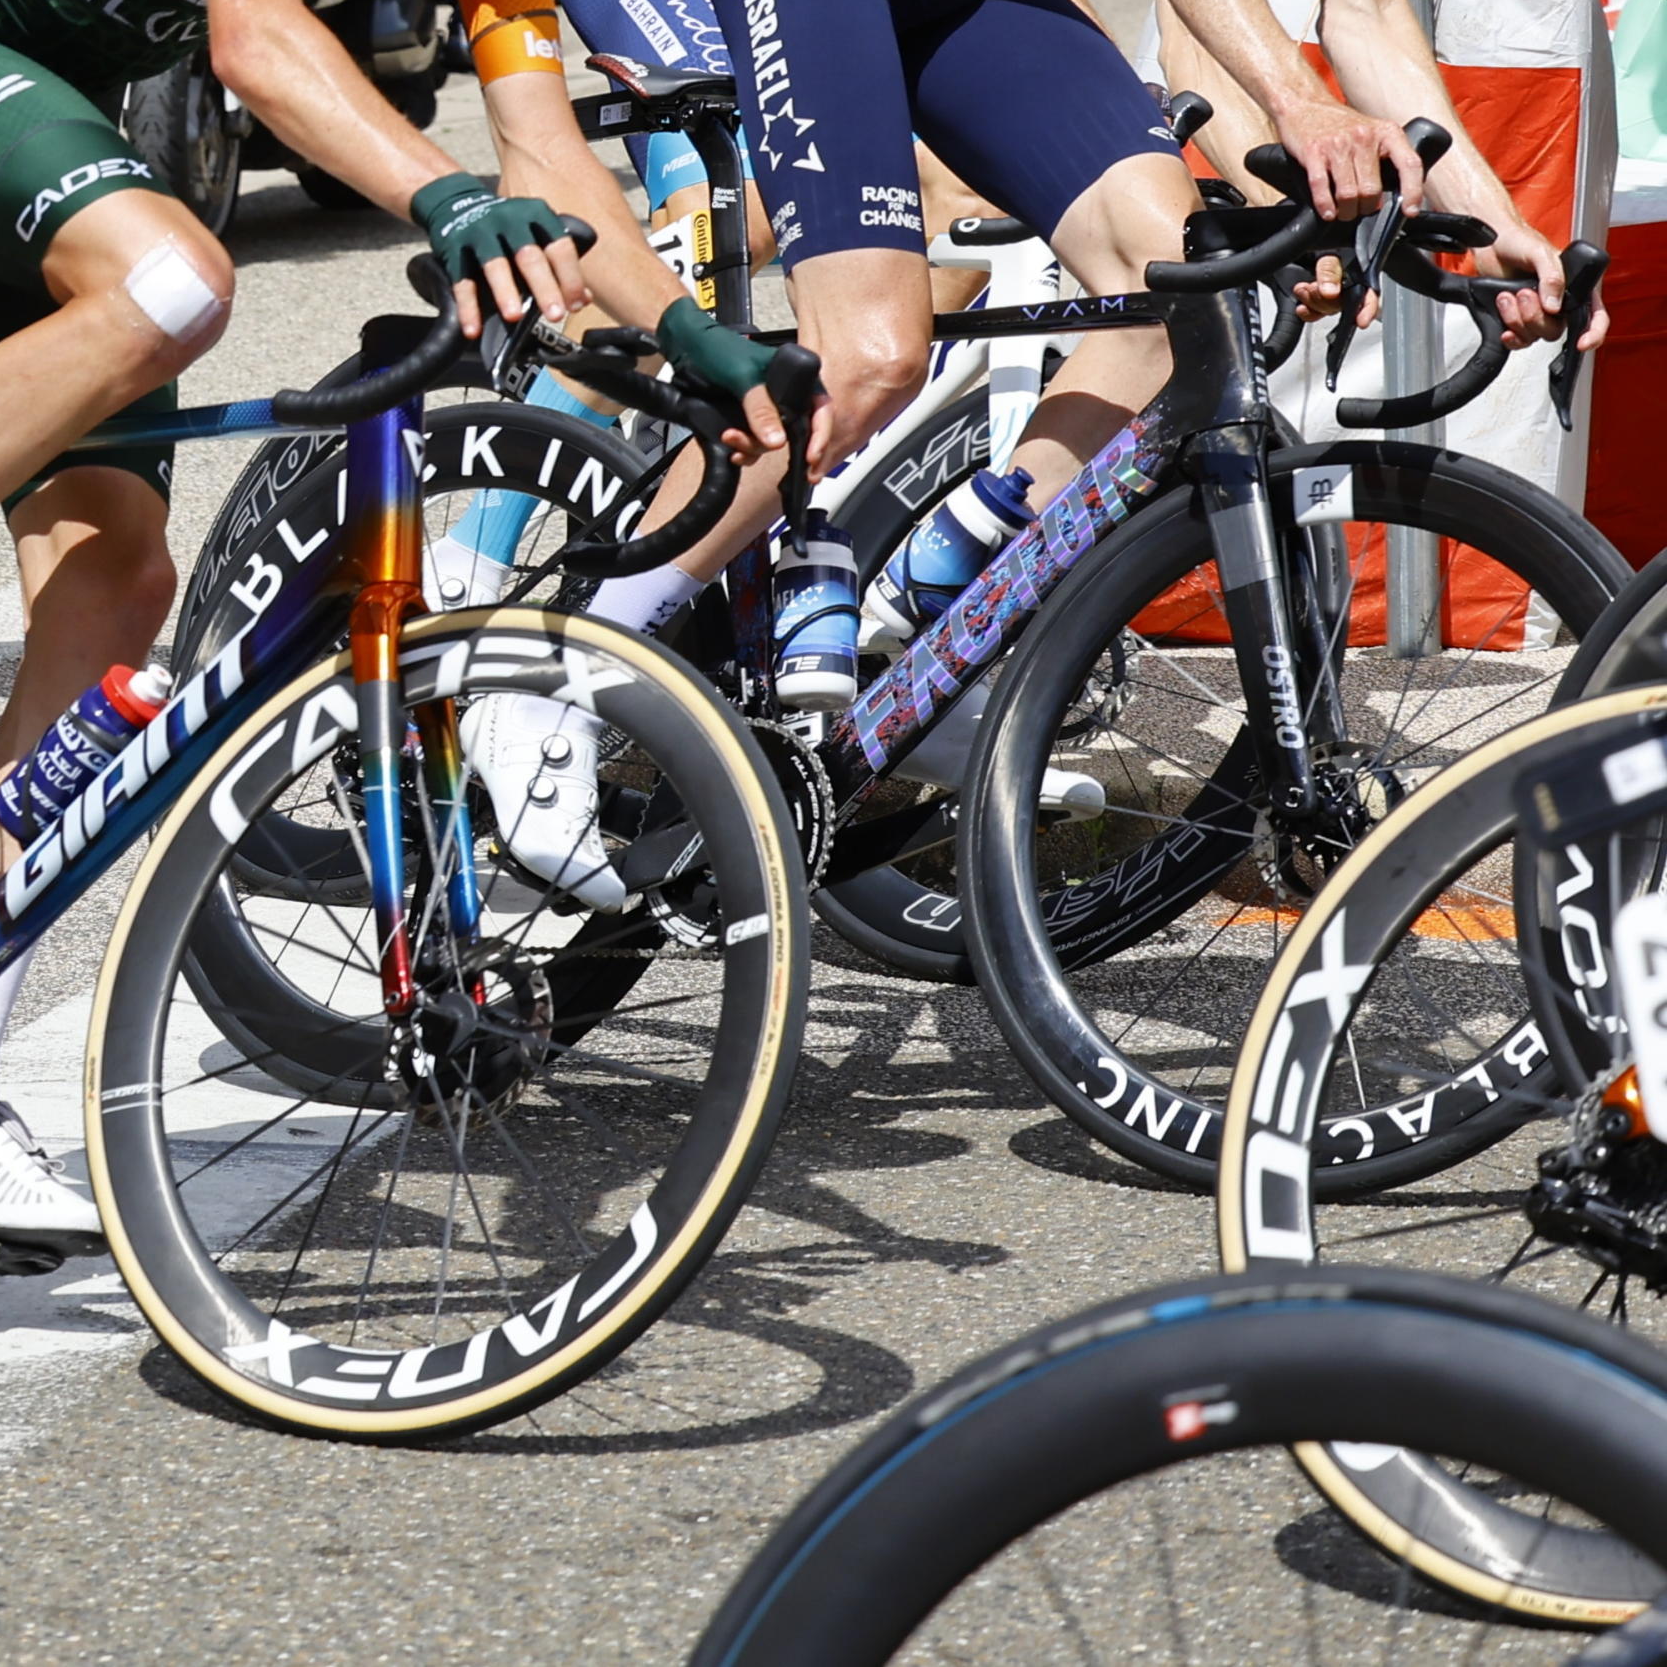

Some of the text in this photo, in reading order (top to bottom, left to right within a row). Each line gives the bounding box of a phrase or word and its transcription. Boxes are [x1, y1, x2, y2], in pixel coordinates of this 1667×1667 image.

[16, 157, 154, 243] CADEX
[859, 209, 923, 234] CHANGE
[861, 186, 919, 209] RACING
[886, 201, 906, 212] FOR
[853, 426, 1160, 776] FACTOR
[1261, 644, 1306, 750] OSTRO
[5, 634, 248, 922] GIANT
[37, 751, 77, 795] ALULA
[1095, 1026, 1551, 1166] BLAC INC
[222, 1200, 659, 1403] CADEX
